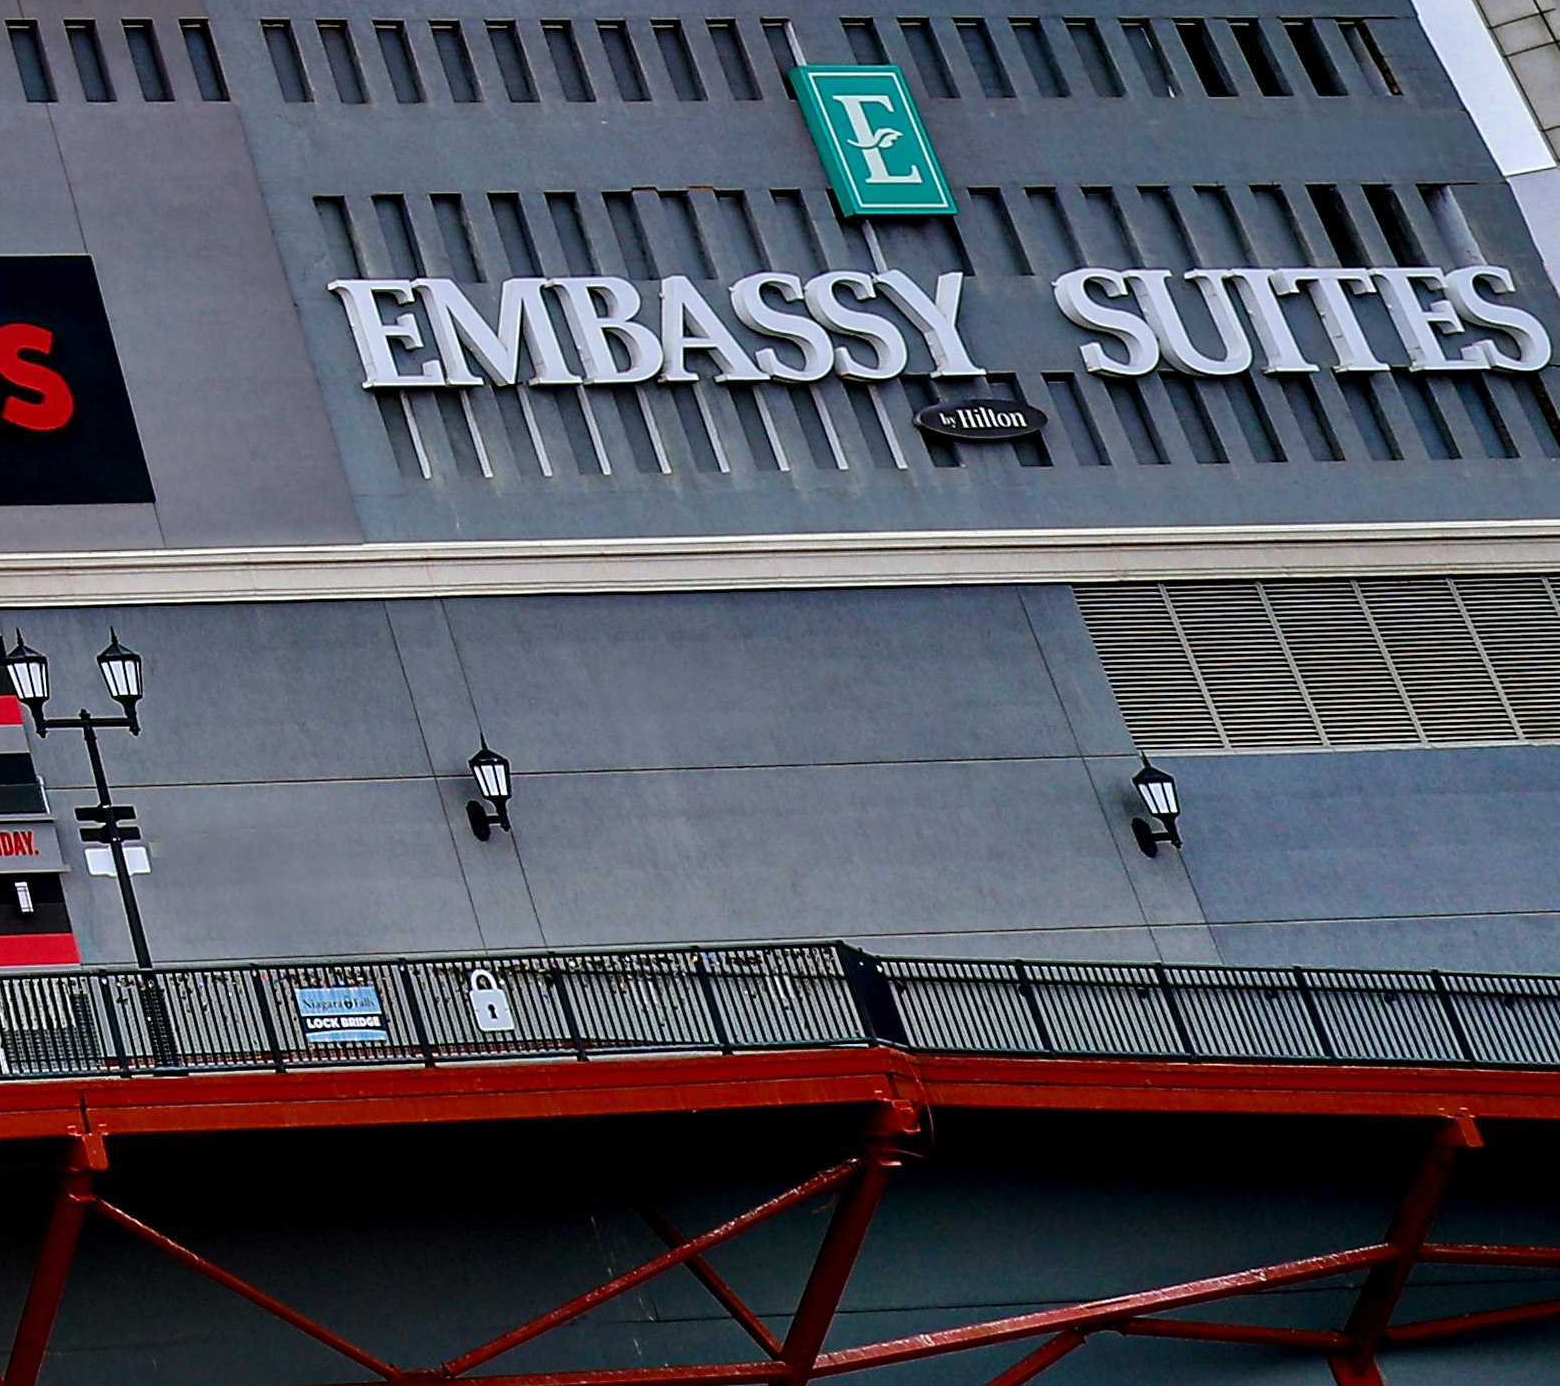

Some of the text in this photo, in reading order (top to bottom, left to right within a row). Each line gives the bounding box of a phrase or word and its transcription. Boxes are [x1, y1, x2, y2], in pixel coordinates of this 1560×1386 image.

[328, 265, 1554, 390] EMBASSY SUITES
[956, 407, 1028, 428] Hilton
[306, 1016, 381, 1029] LOCK BRIDGE
